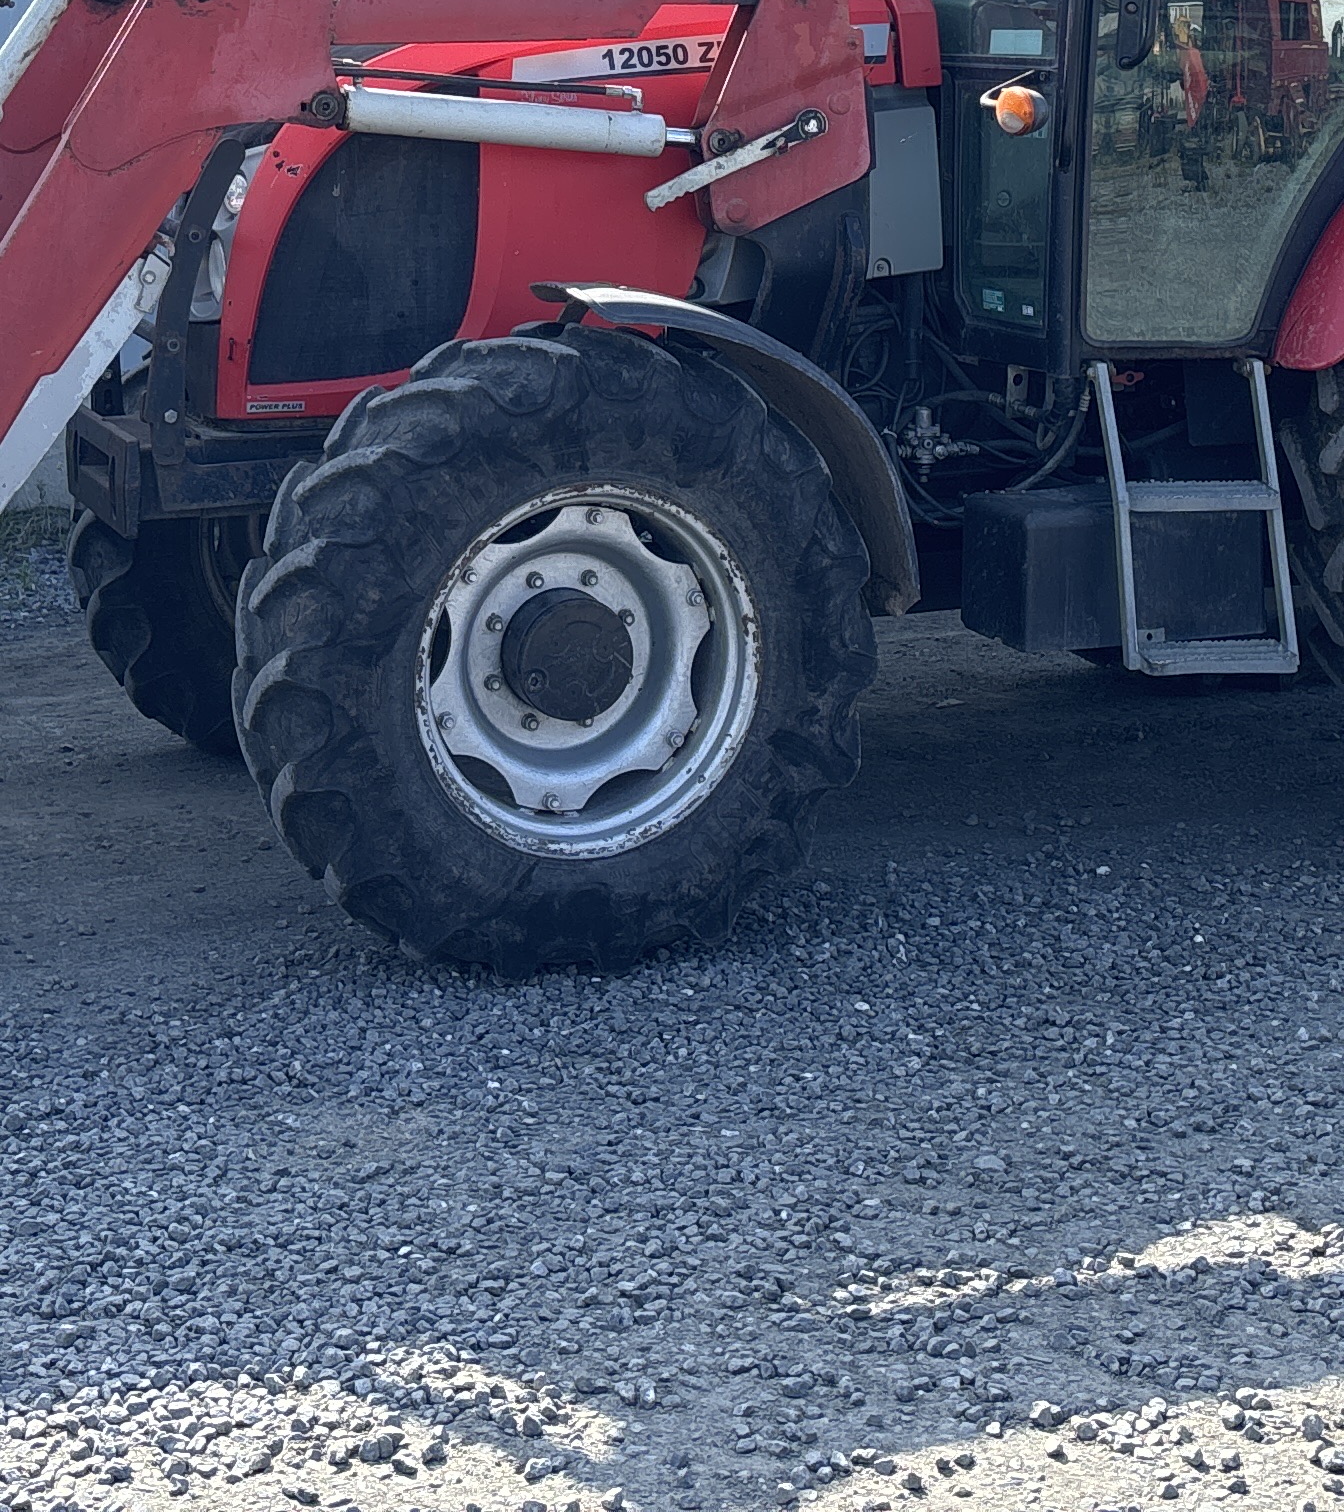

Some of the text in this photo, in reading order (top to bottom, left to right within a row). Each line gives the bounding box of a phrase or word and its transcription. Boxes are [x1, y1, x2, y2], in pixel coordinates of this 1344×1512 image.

[601, 40, 723, 71] 12050 Z
[281, 402, 303, 410] PLUS
